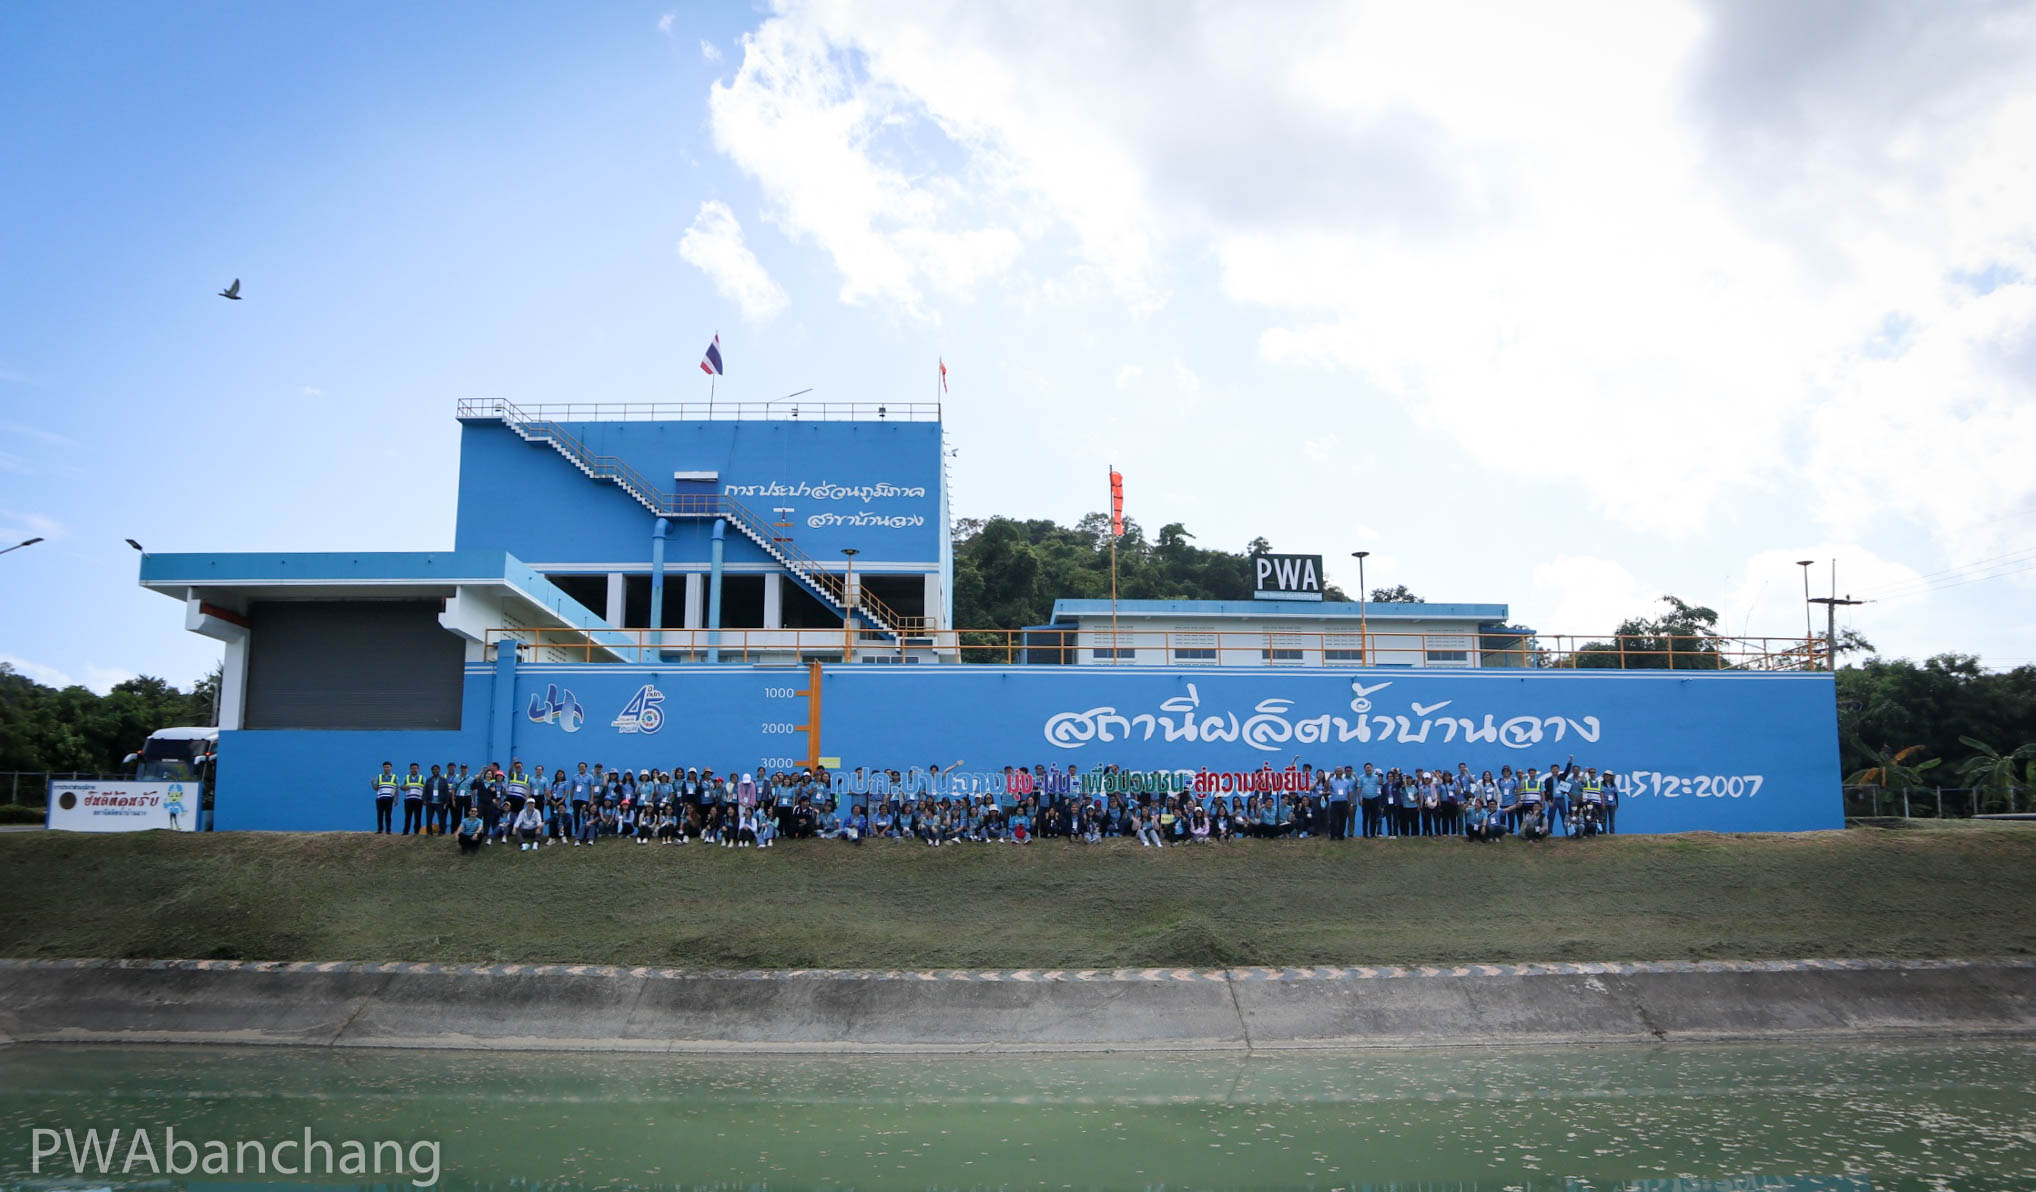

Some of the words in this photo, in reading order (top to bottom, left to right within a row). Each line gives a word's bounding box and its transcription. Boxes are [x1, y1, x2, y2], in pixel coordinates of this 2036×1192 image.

[724, 480, 926, 503] การประปาส่วนภูมิภาค
[807, 511, 925, 529] สาขาบ้านฉาง
[1257, 558, 1319, 590] PWA
[764, 687, 794, 698] 1000
[619, 686, 664, 733] 45
[1044, 682, 1601, 751] สถานีผลิตน้ำบ้านฉาง
[762, 723, 794, 734] 2000
[761, 758, 793, 769] 3000
[1600, 770, 1764, 798] 4512:2007
